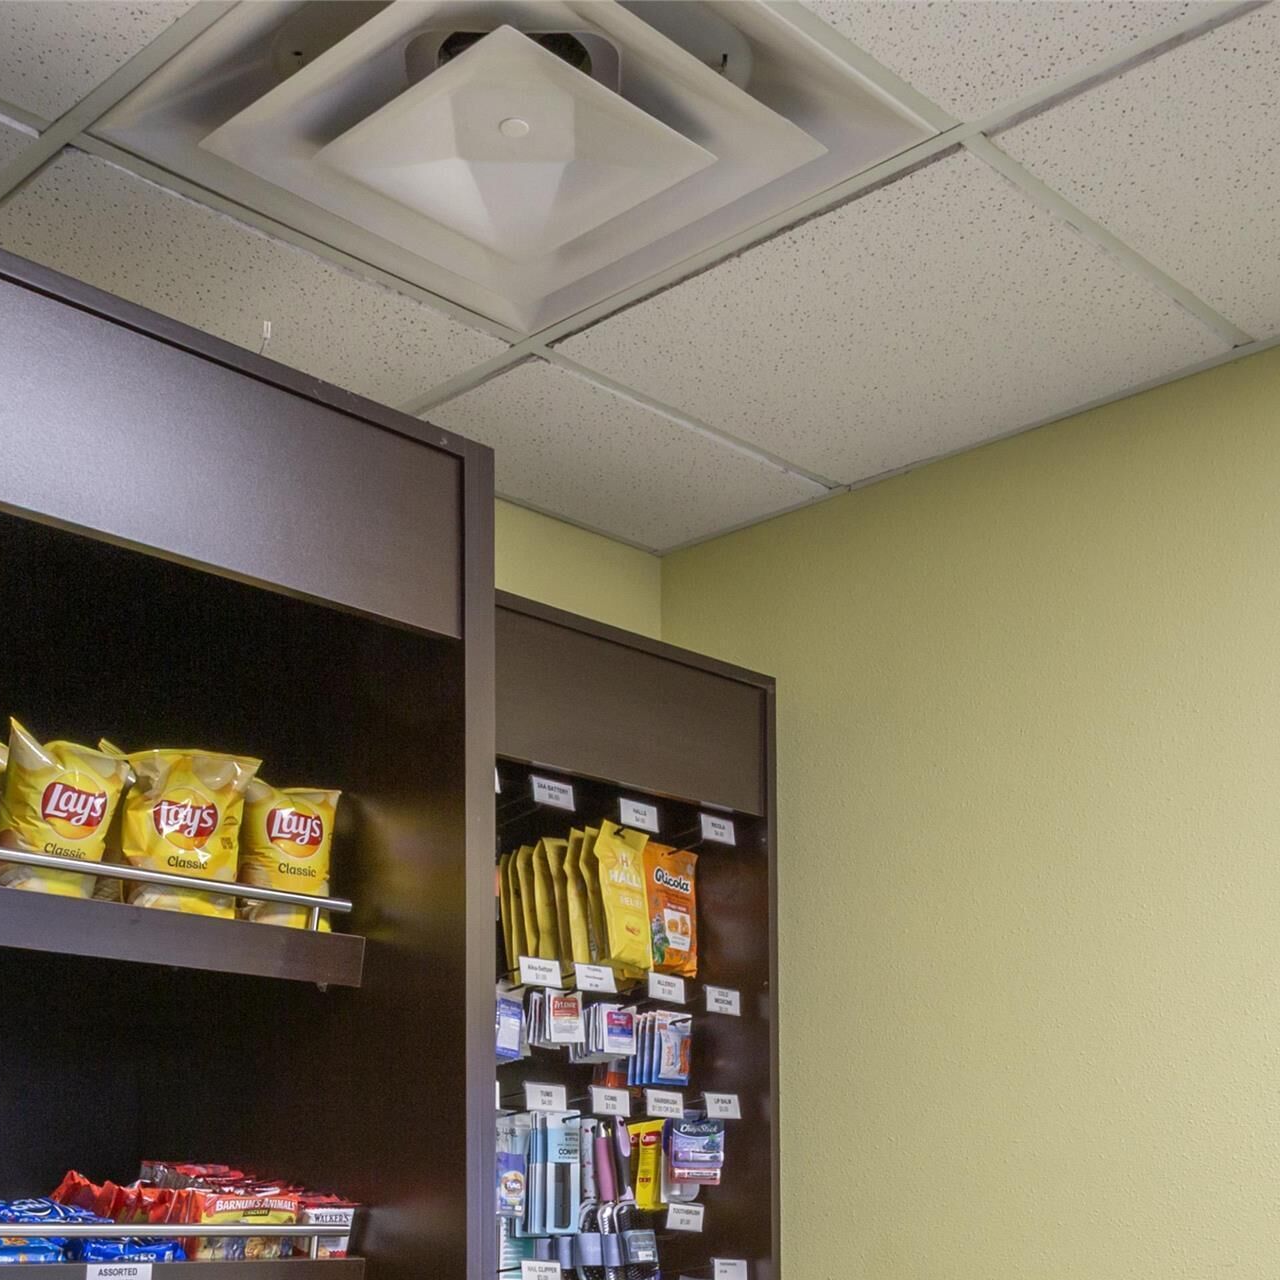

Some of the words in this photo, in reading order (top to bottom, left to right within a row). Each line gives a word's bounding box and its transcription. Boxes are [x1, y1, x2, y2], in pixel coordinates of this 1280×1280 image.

[44, 783, 107, 826] Lay's
[159, 801, 214, 838] Lay's
[270, 809, 322, 845] Lay's
[43, 842, 87, 859] Classic
[167, 855, 209, 870] Classic
[278, 862, 317, 878] Classic
[655, 867, 690, 893] Ricola
[215, 1199, 261, 1212] BARNUM'S
[261, 1197, 296, 1211] ANIMALS
[97, 1267, 138, 1277] ASSORTED
